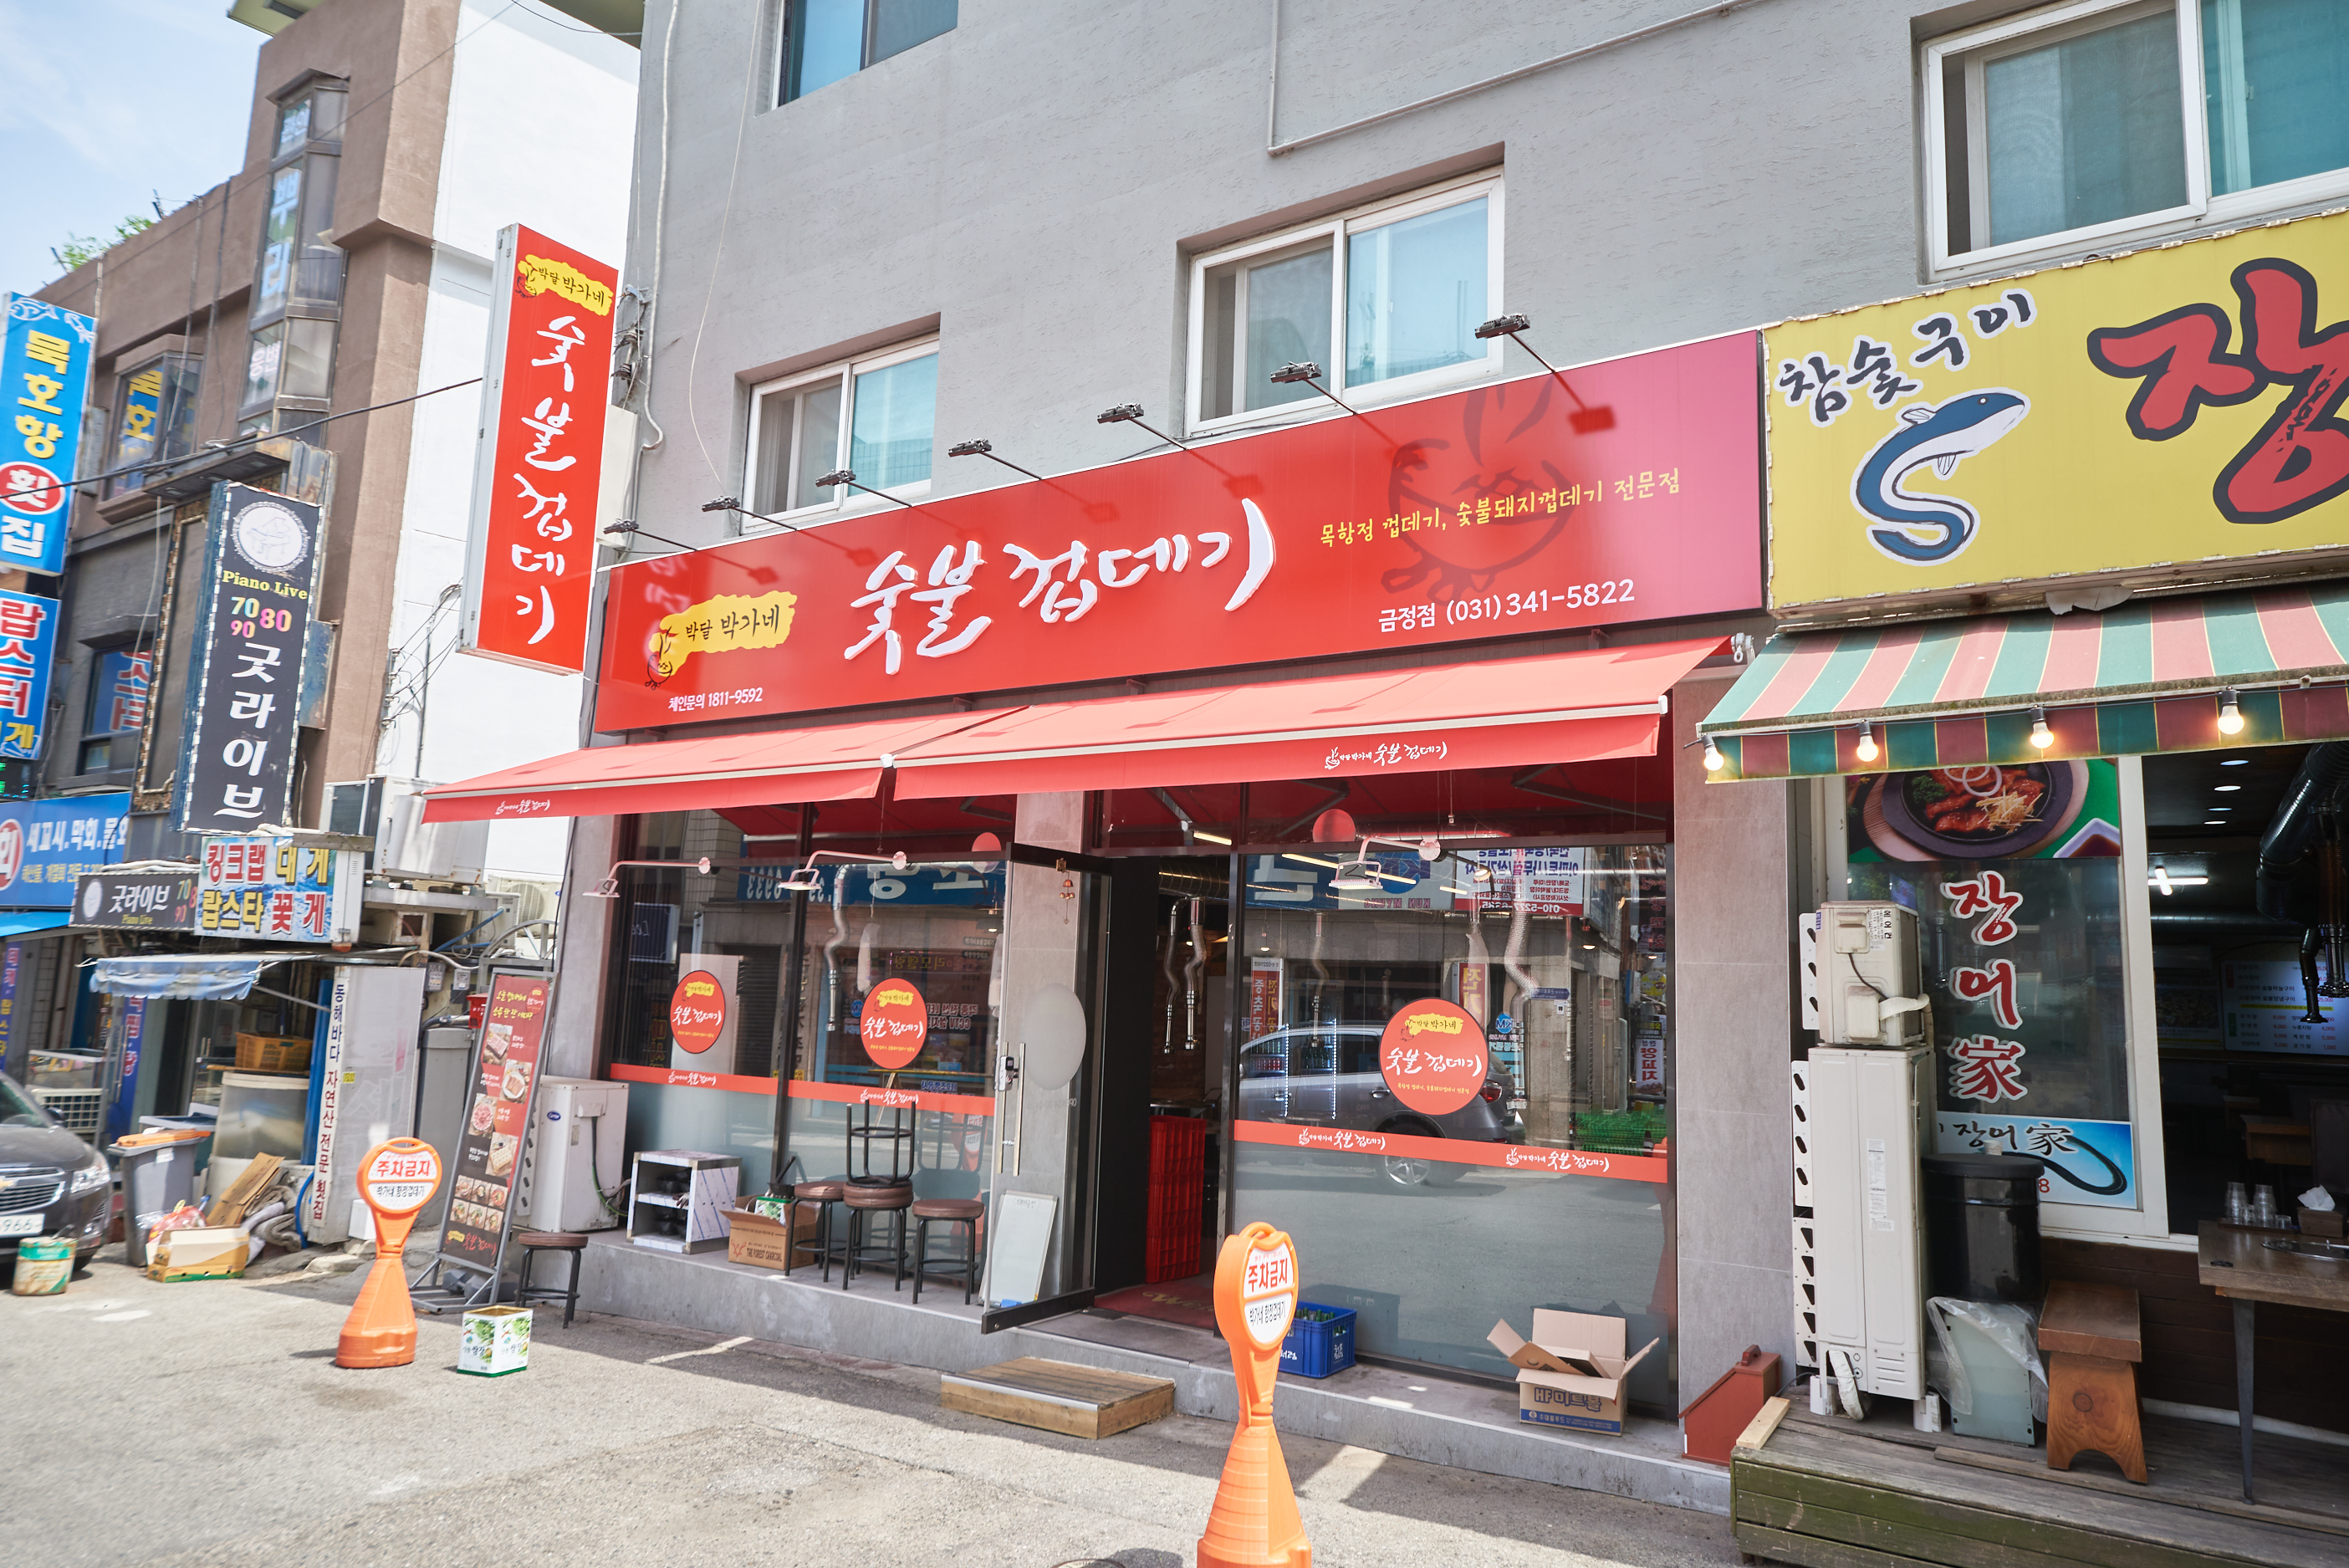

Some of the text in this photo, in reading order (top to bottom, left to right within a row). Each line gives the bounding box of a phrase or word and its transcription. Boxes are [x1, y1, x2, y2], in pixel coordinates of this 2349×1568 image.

[563, 275, 605, 308] 박가네
[1, 469, 49, 558] 횟집
[1320, 518, 1374, 548] 목항정
[1456, 480, 1604, 526] 숯불돼지껍데기
[1614, 467, 1680, 502] 전문점
[222, 569, 308, 600] Piano Live
[844, 498, 1276, 676] 숯불 껍데기
[231, 596, 292, 632] 70 80
[231, 621, 255, 638] 90
[685, 604, 779, 641] 박달 박가네
[1379, 601, 1436, 633] 금정점
[668, 687, 763, 712] 체인문의 1811-9592
[213, 641, 282, 818] 굿라이브
[1374, 743, 1402, 766] 숯불
[1403, 741, 1448, 759] 껍데기
[207, 845, 330, 886] 킹크랩 대게
[108, 885, 171, 913] 굿라이브
[202, 890, 327, 937] 랍스타 꽃게
[1431, 1019, 1457, 1029] 박가네
[1386, 1047, 1482, 1077] 숯불 껍데기
[323, 1070, 338, 1128] 자연산
[1954, 1121, 2017, 1150] 장어
[319, 1133, 331, 1173] 전문
[377, 1160, 430, 1177] 주차금지
[313, 1180, 326, 1220] 횟집
[0, 1217, 33, 1233] 966
[1249, 1258, 1288, 1293] 주차금지
[1249, 1305, 1264, 1327] 박가네
[1535, 1387, 1552, 1402] HF
